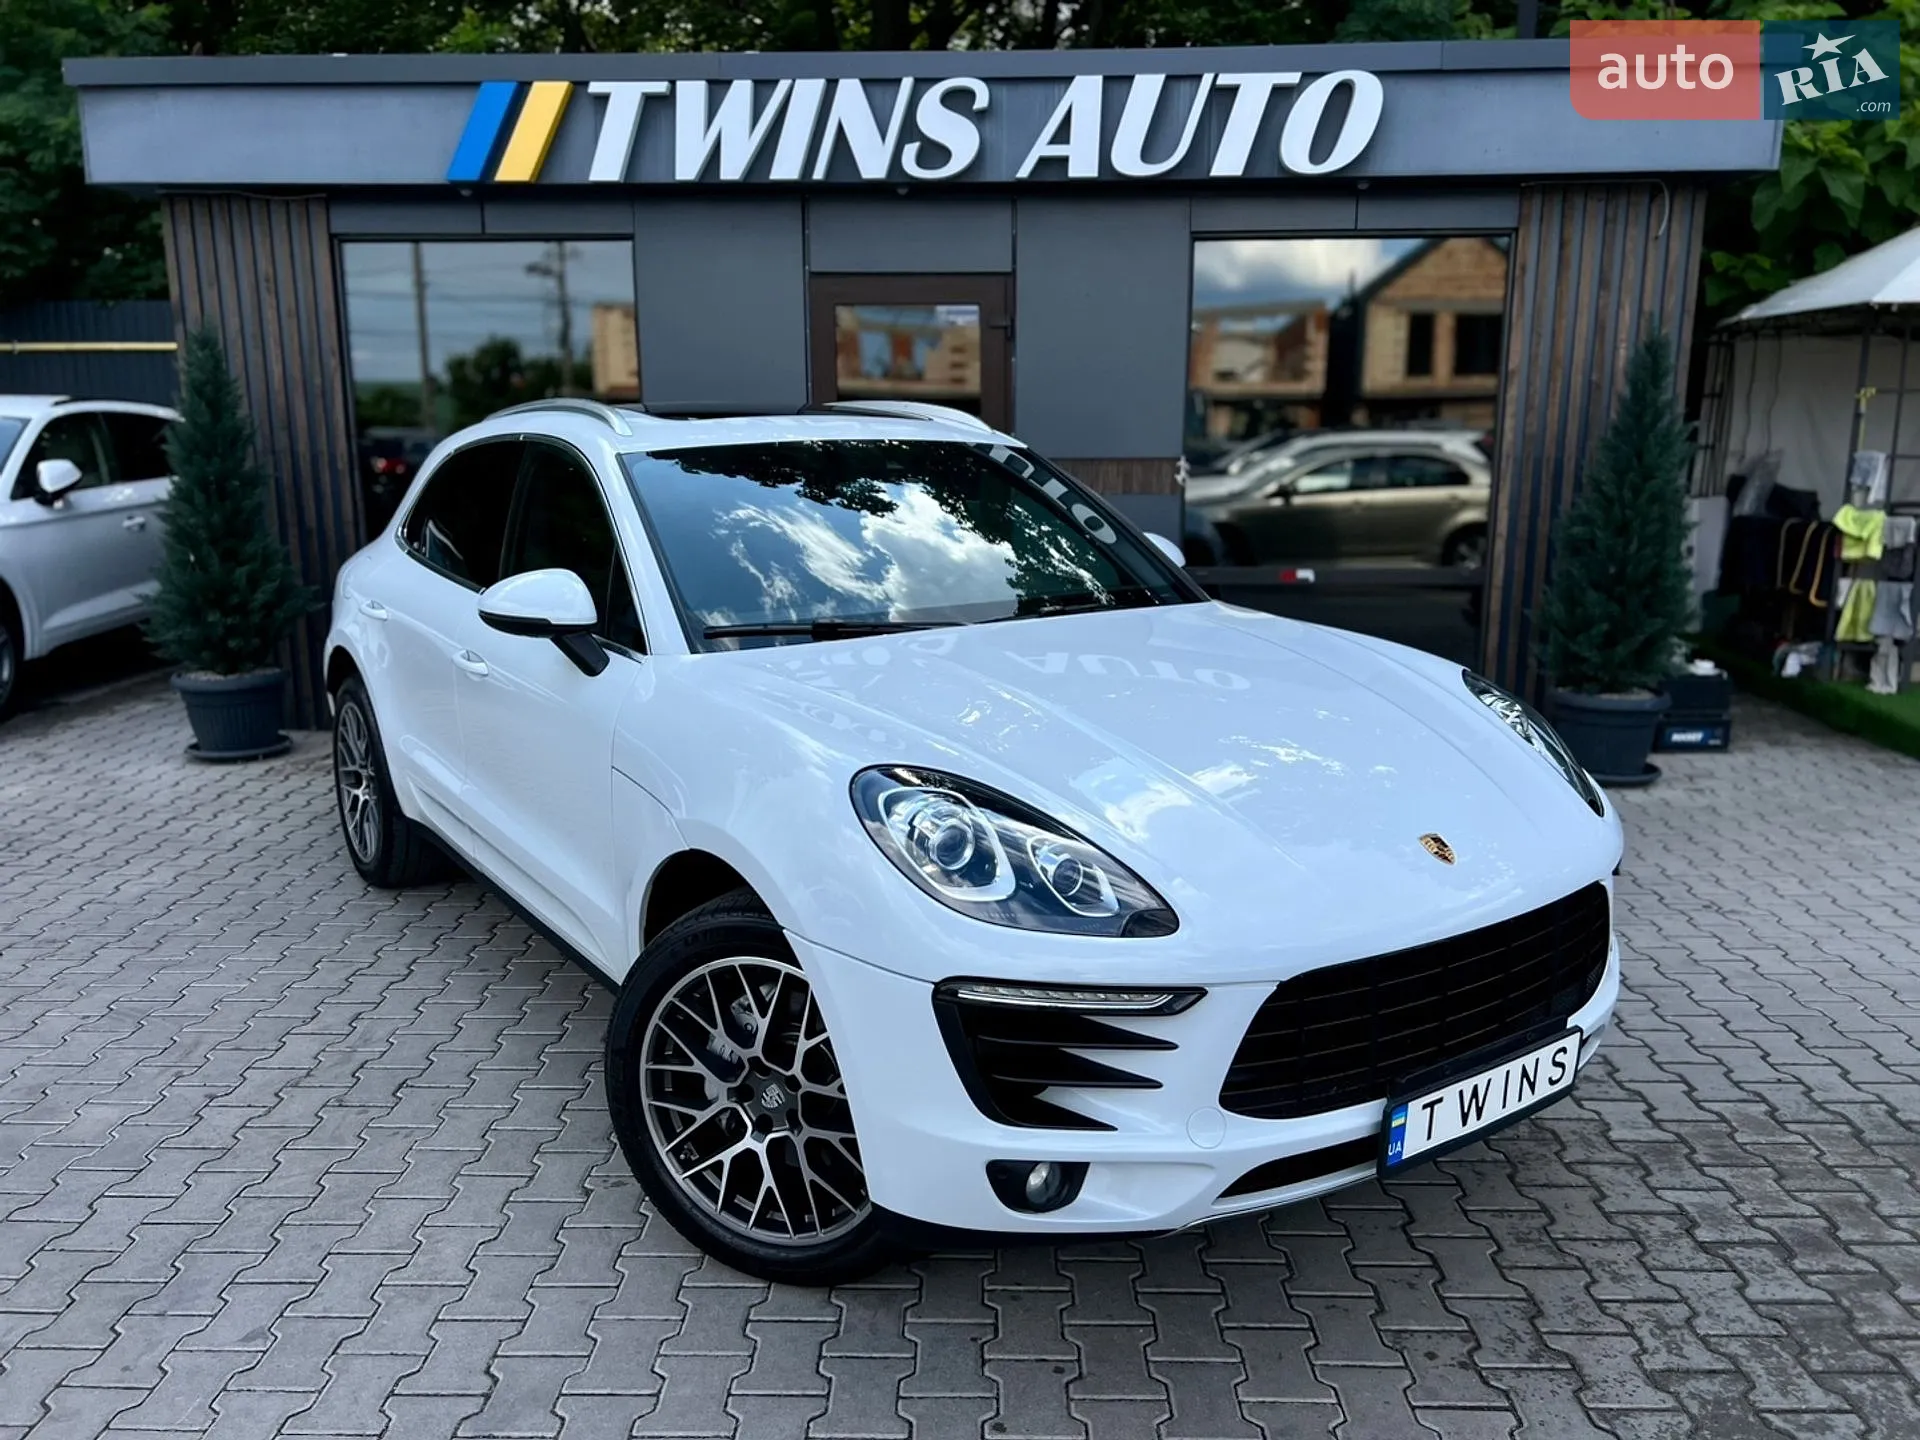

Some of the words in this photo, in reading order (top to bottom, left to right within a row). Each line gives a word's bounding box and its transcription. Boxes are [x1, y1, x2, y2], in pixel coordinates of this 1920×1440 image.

[588, 77, 990, 182] TWINS
[1016, 70, 1384, 178] AUTO
[1422, 1046, 1568, 1141] TWINS
[1388, 1141, 1401, 1155] UA
